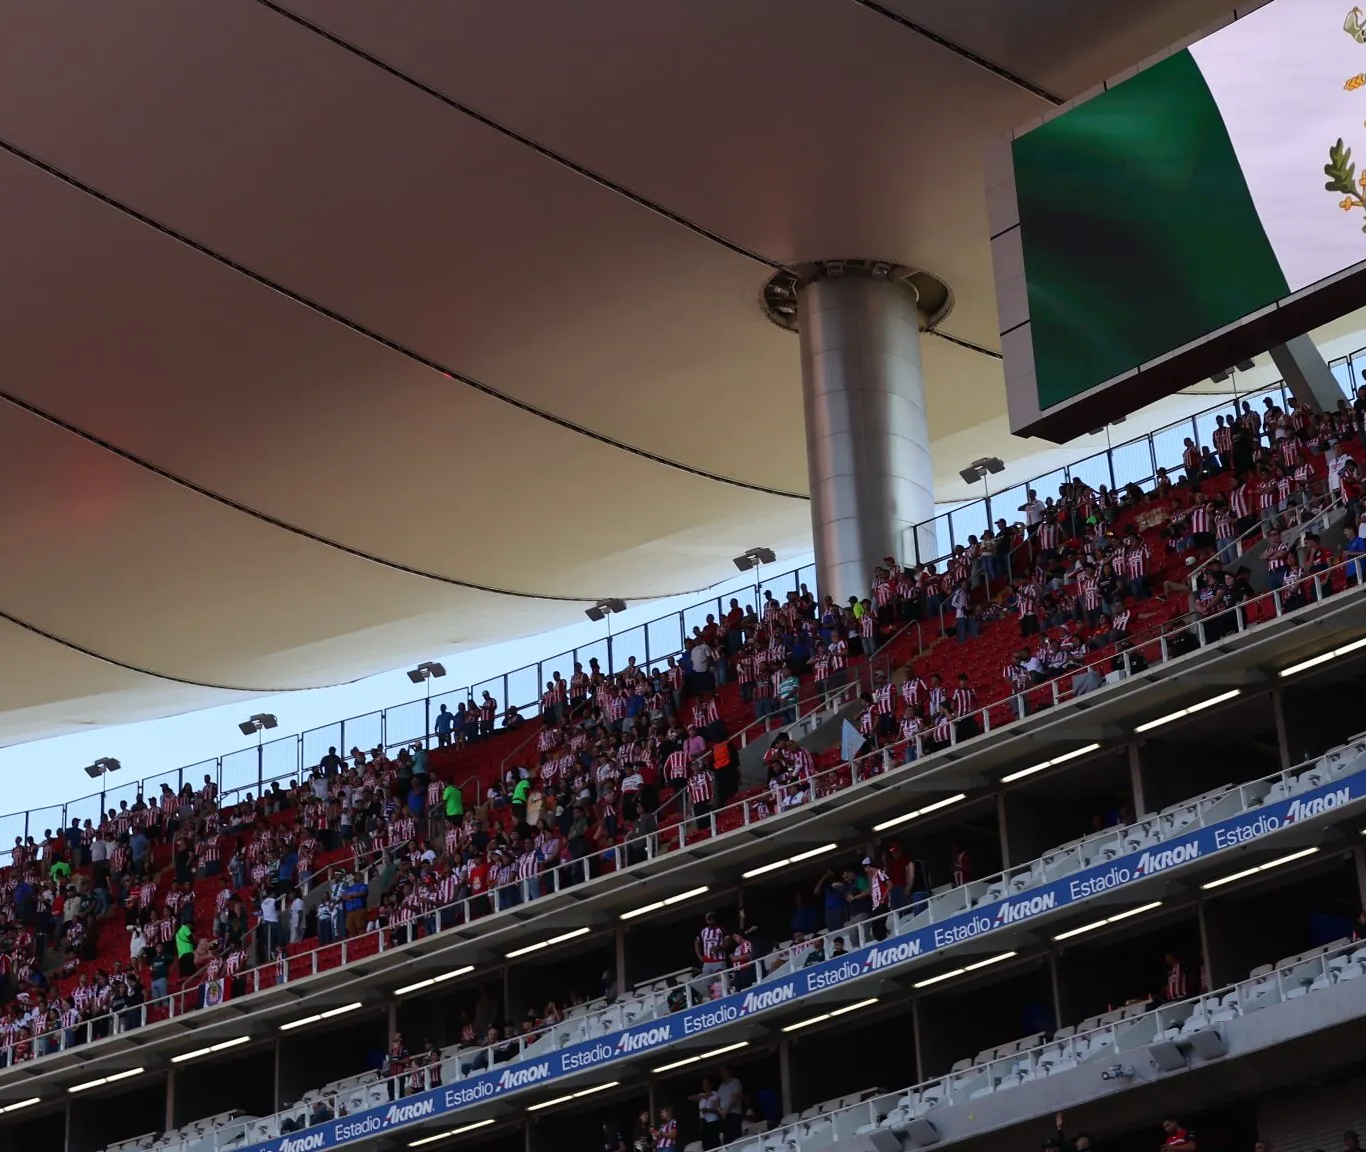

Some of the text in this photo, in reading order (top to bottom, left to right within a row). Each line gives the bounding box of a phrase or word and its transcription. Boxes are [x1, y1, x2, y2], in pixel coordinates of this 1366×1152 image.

[1215, 787, 1351, 848] Estadio AKRON
[1070, 841, 1201, 899] Estadio AKRON
[935, 892, 1055, 948] Estadio AKRON
[807, 939, 921, 992] Estadio AKRON
[684, 983, 794, 1033] Estadio AKRON
[562, 1025, 671, 1071] Estadio AKRON
[446, 1063, 549, 1107] Estadio AKRON
[335, 1099, 434, 1141] Estadio AKRON
